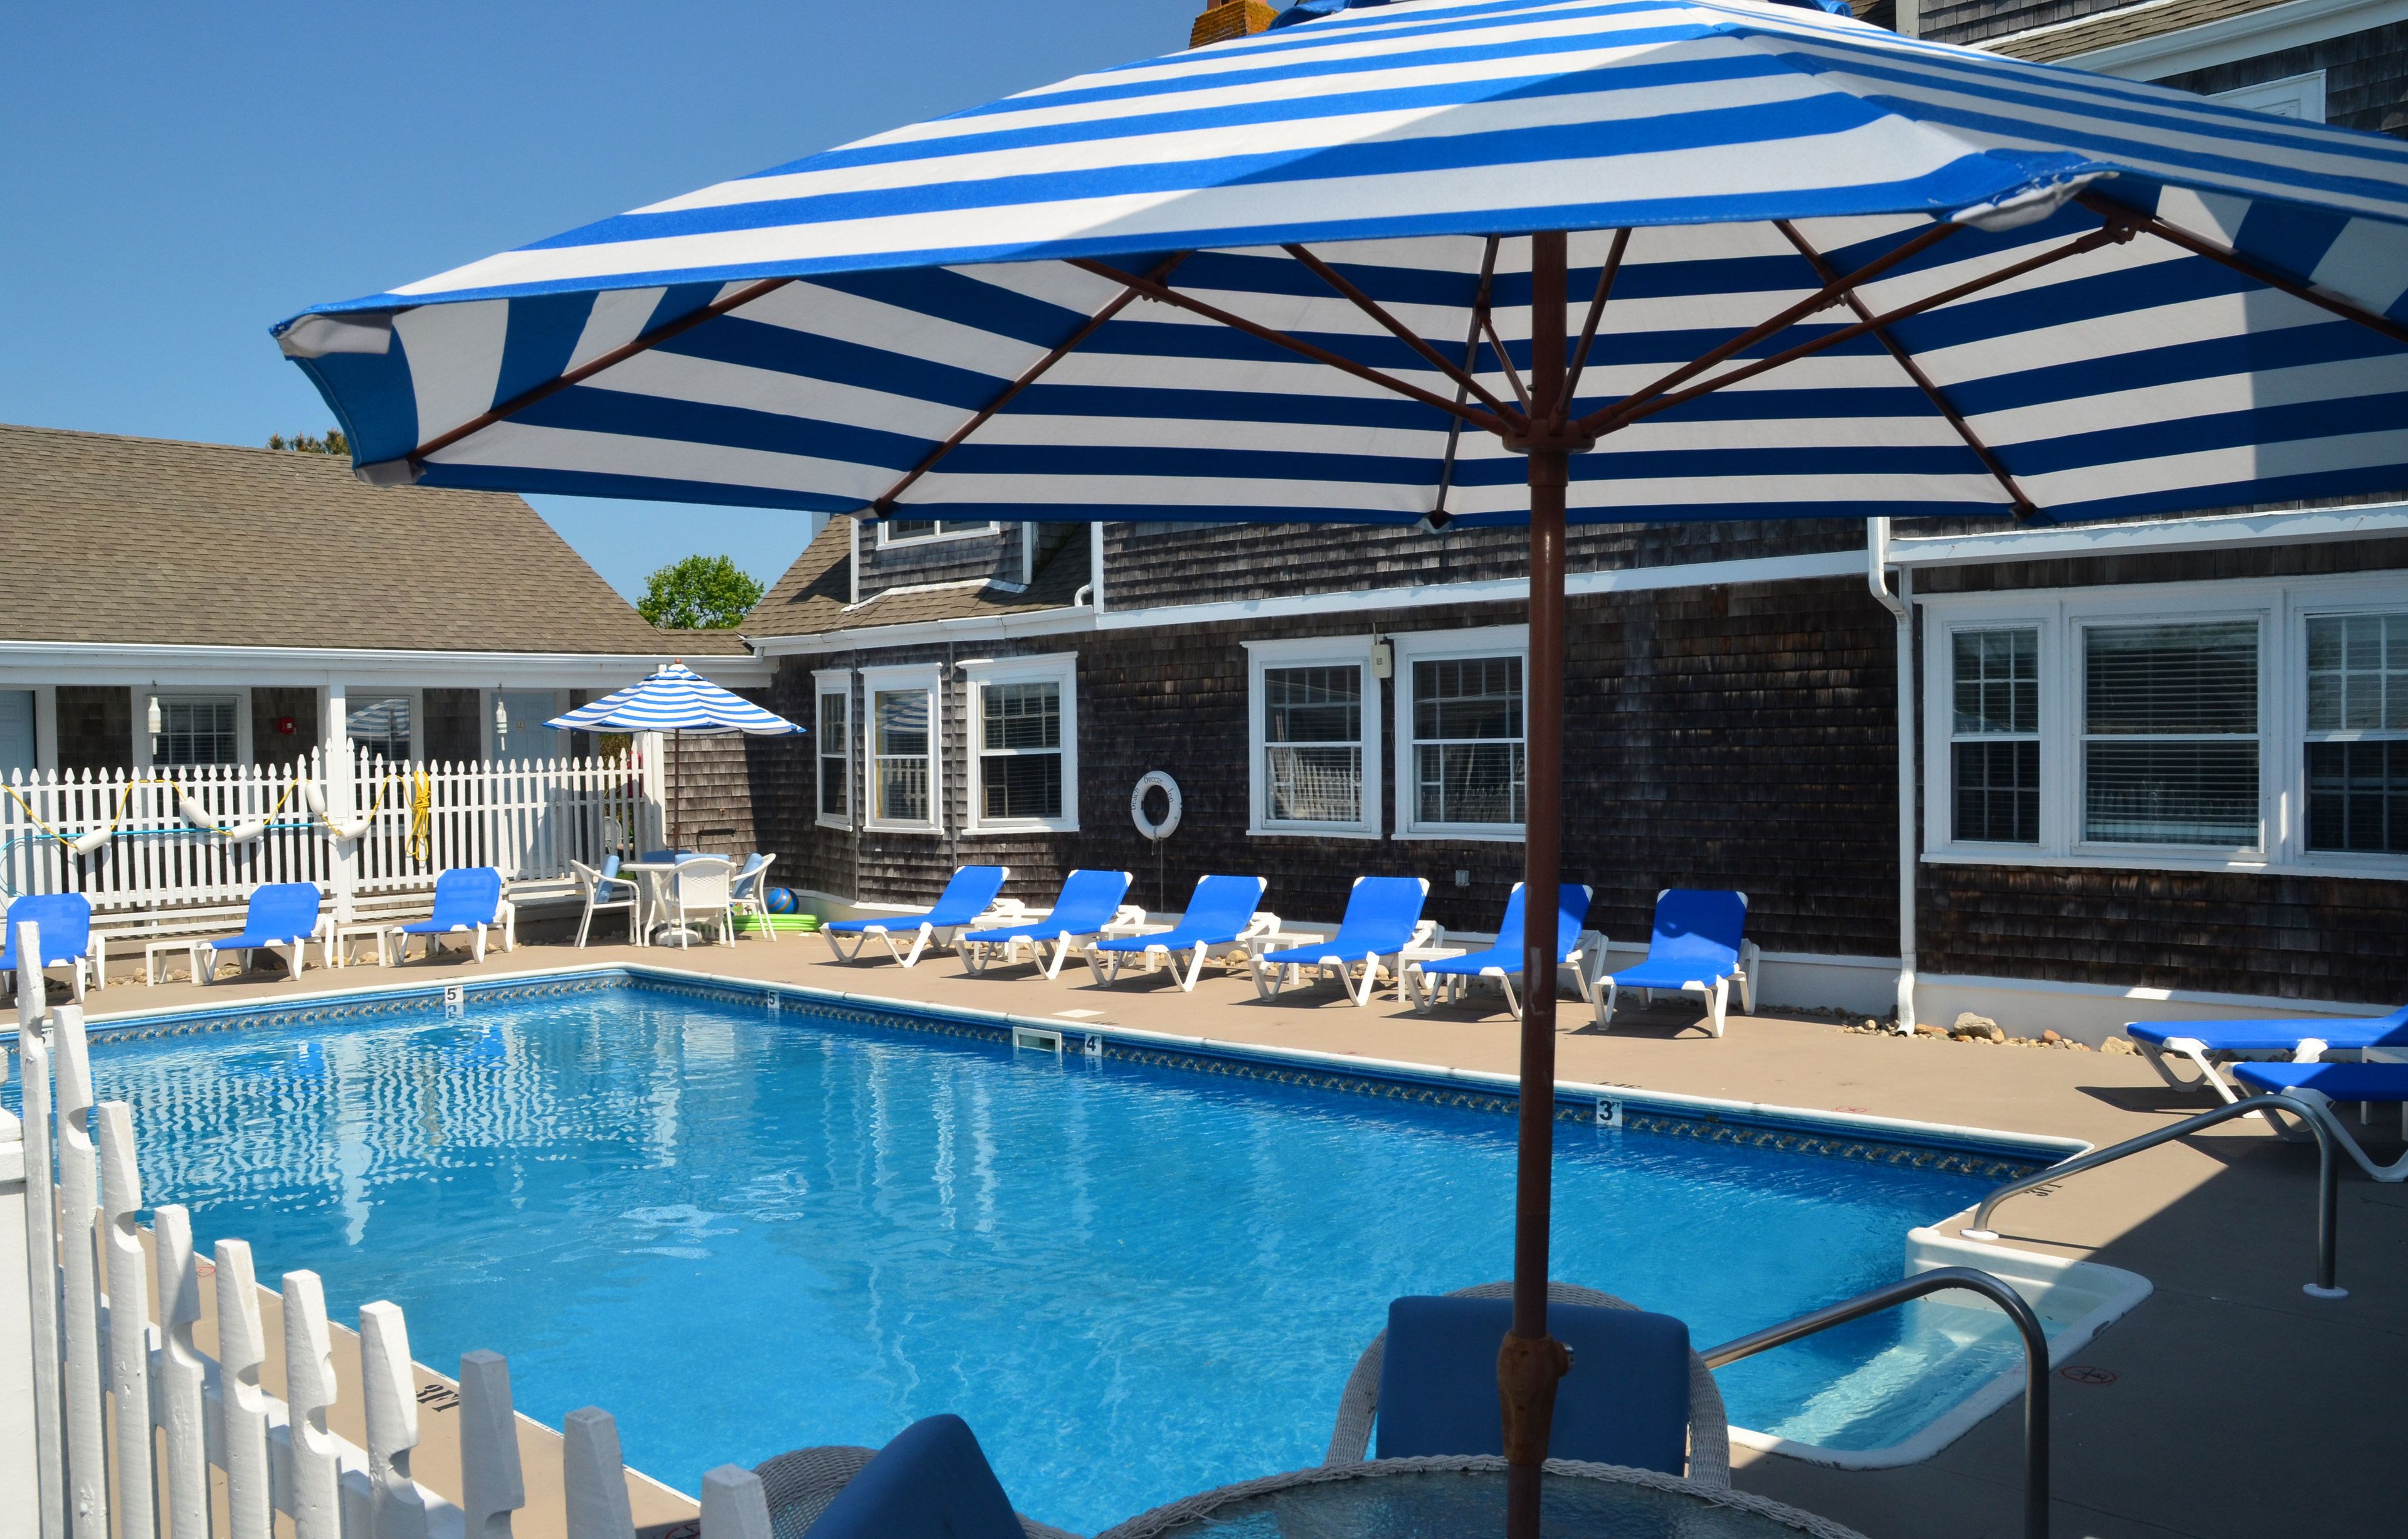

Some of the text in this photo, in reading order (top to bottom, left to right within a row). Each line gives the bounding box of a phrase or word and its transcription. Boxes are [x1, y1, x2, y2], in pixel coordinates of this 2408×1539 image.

[1143, 775, 1163, 785] Breeze
[447, 988, 457, 1001] 5
[769, 992, 775, 1005] 5
[1086, 1035, 1096, 1052] 4
[1599, 1100, 1613, 1121] 3
